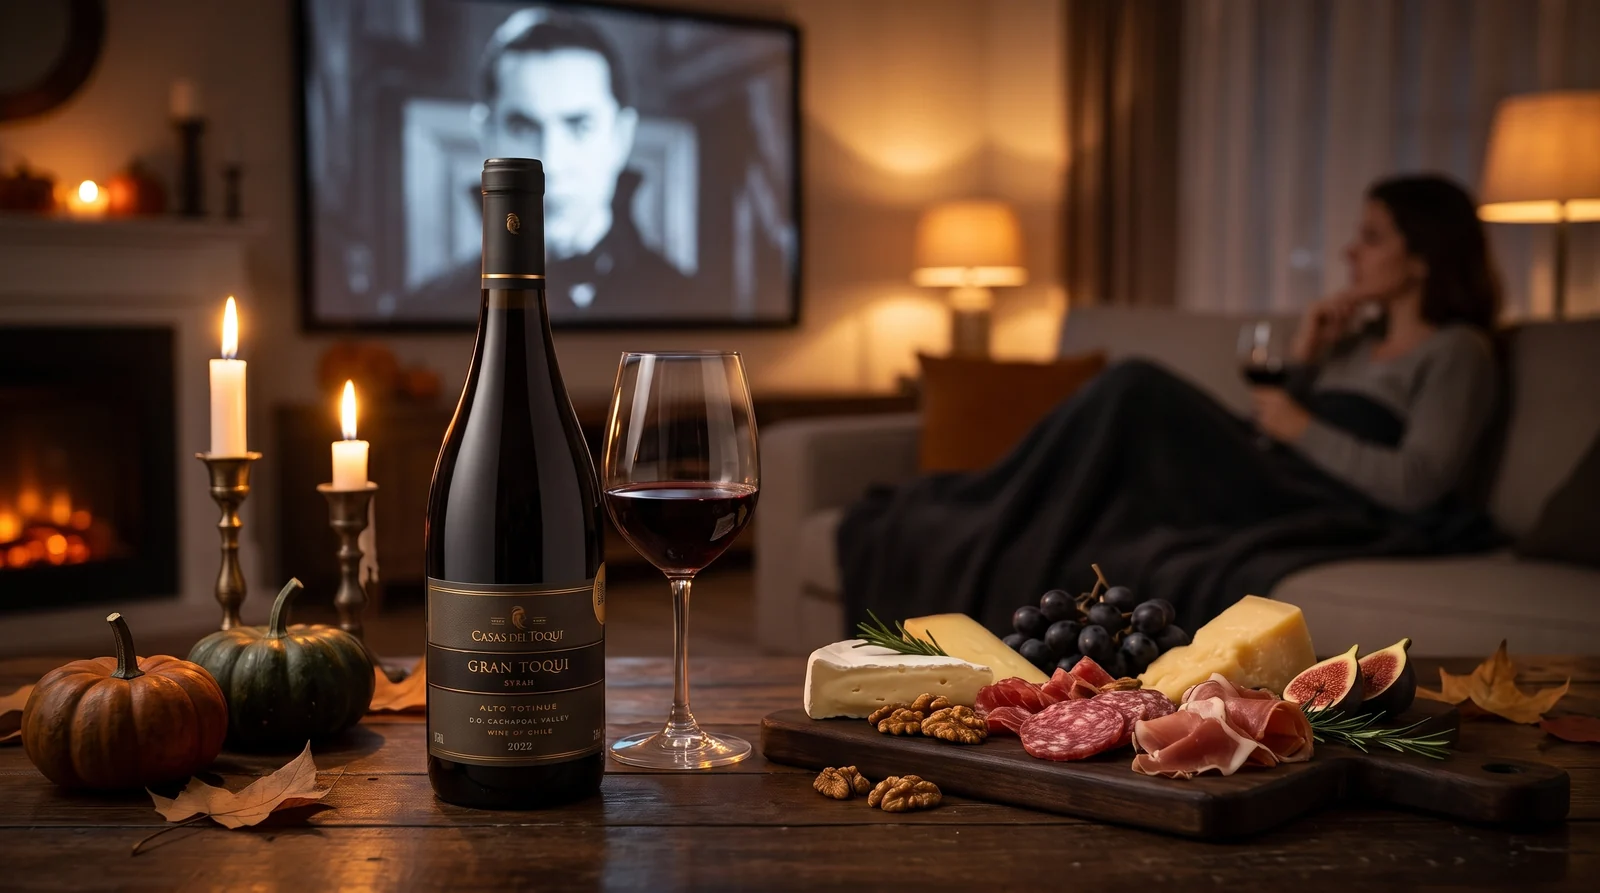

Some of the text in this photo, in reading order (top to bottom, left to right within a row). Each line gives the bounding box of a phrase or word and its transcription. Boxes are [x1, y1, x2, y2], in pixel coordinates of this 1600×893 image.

[472, 630, 506, 642] CASAS
[528, 630, 563, 642] TOQUI
[468, 659, 568, 673] GRAN TOQUI
[504, 679, 534, 687] SYRAH
[511, 703, 557, 712] TOTINUE
[541, 715, 569, 723] VALLEY
[527, 728, 553, 736] CHILE
[507, 742, 532, 751] 2022
